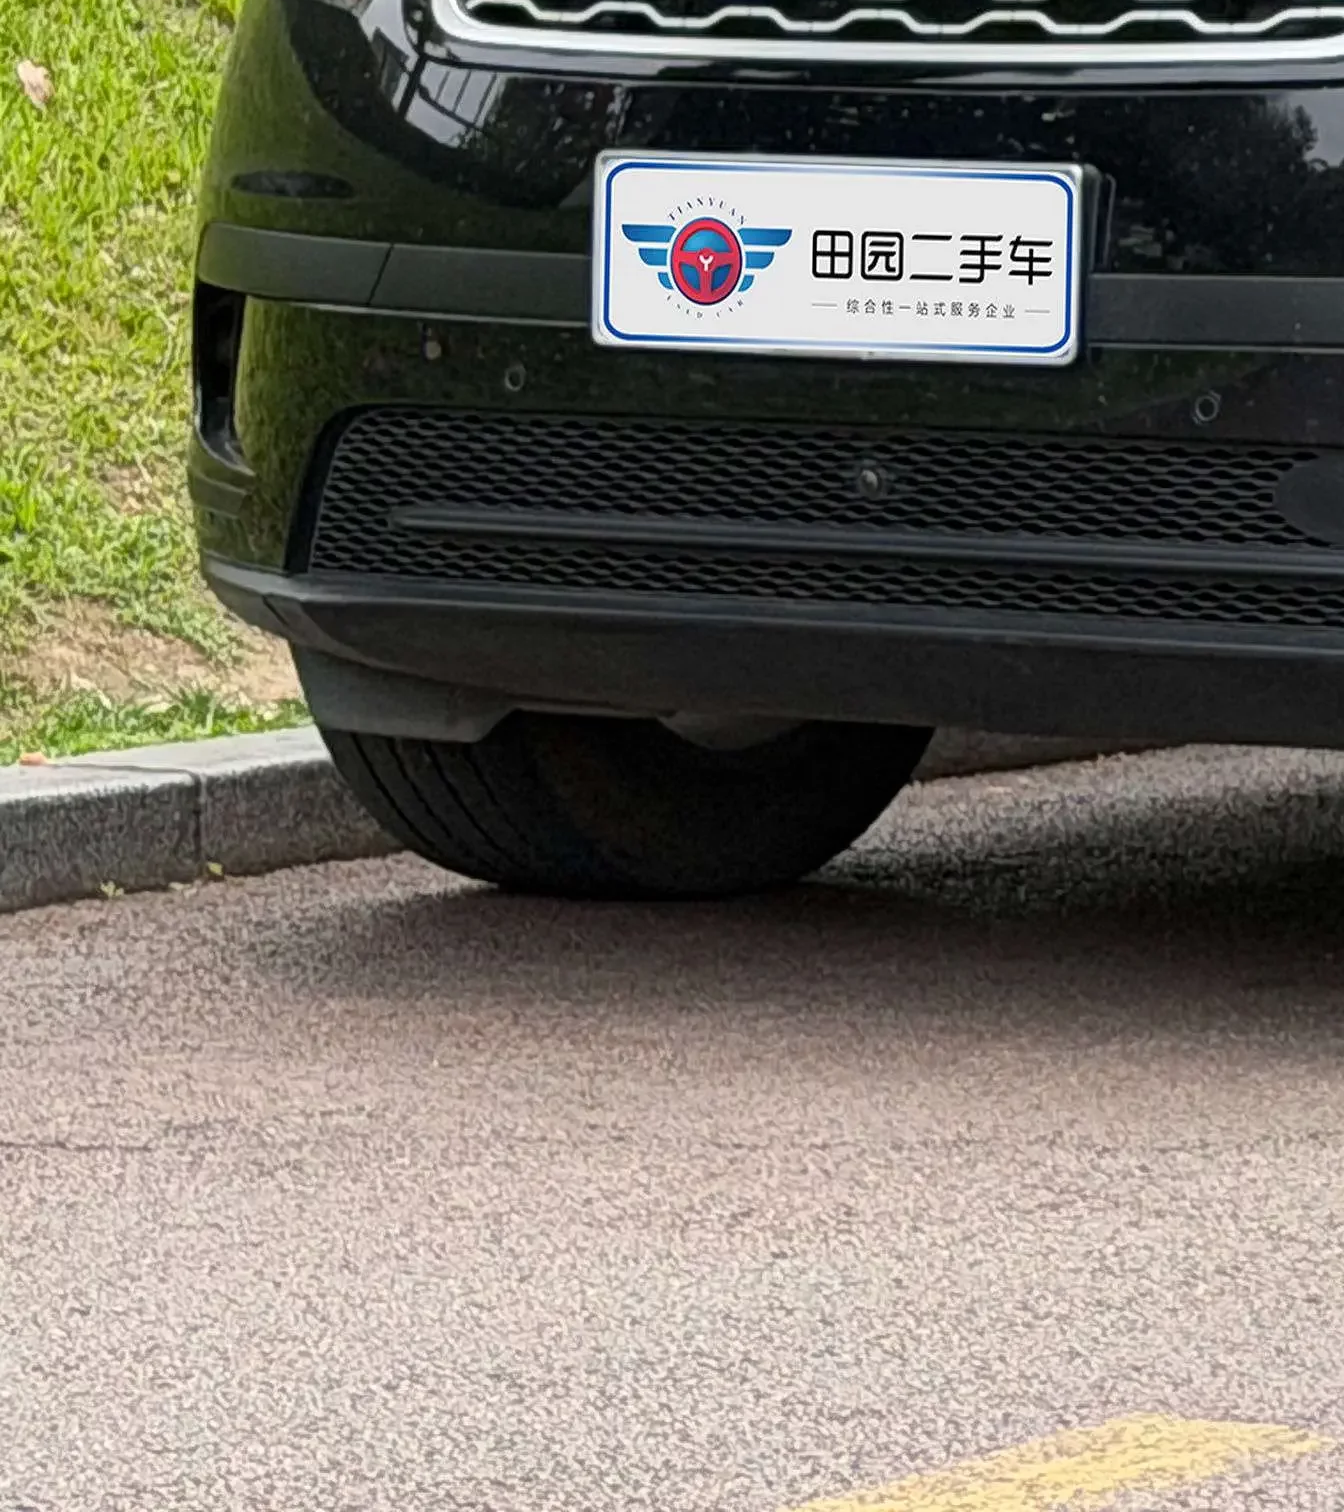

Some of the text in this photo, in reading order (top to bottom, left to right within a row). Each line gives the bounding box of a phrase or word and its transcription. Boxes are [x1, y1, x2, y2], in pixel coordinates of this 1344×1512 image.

[811, 229, 1054, 286] 田园二手车
[846, 298, 1016, 319] 综合性一站式服务企业
